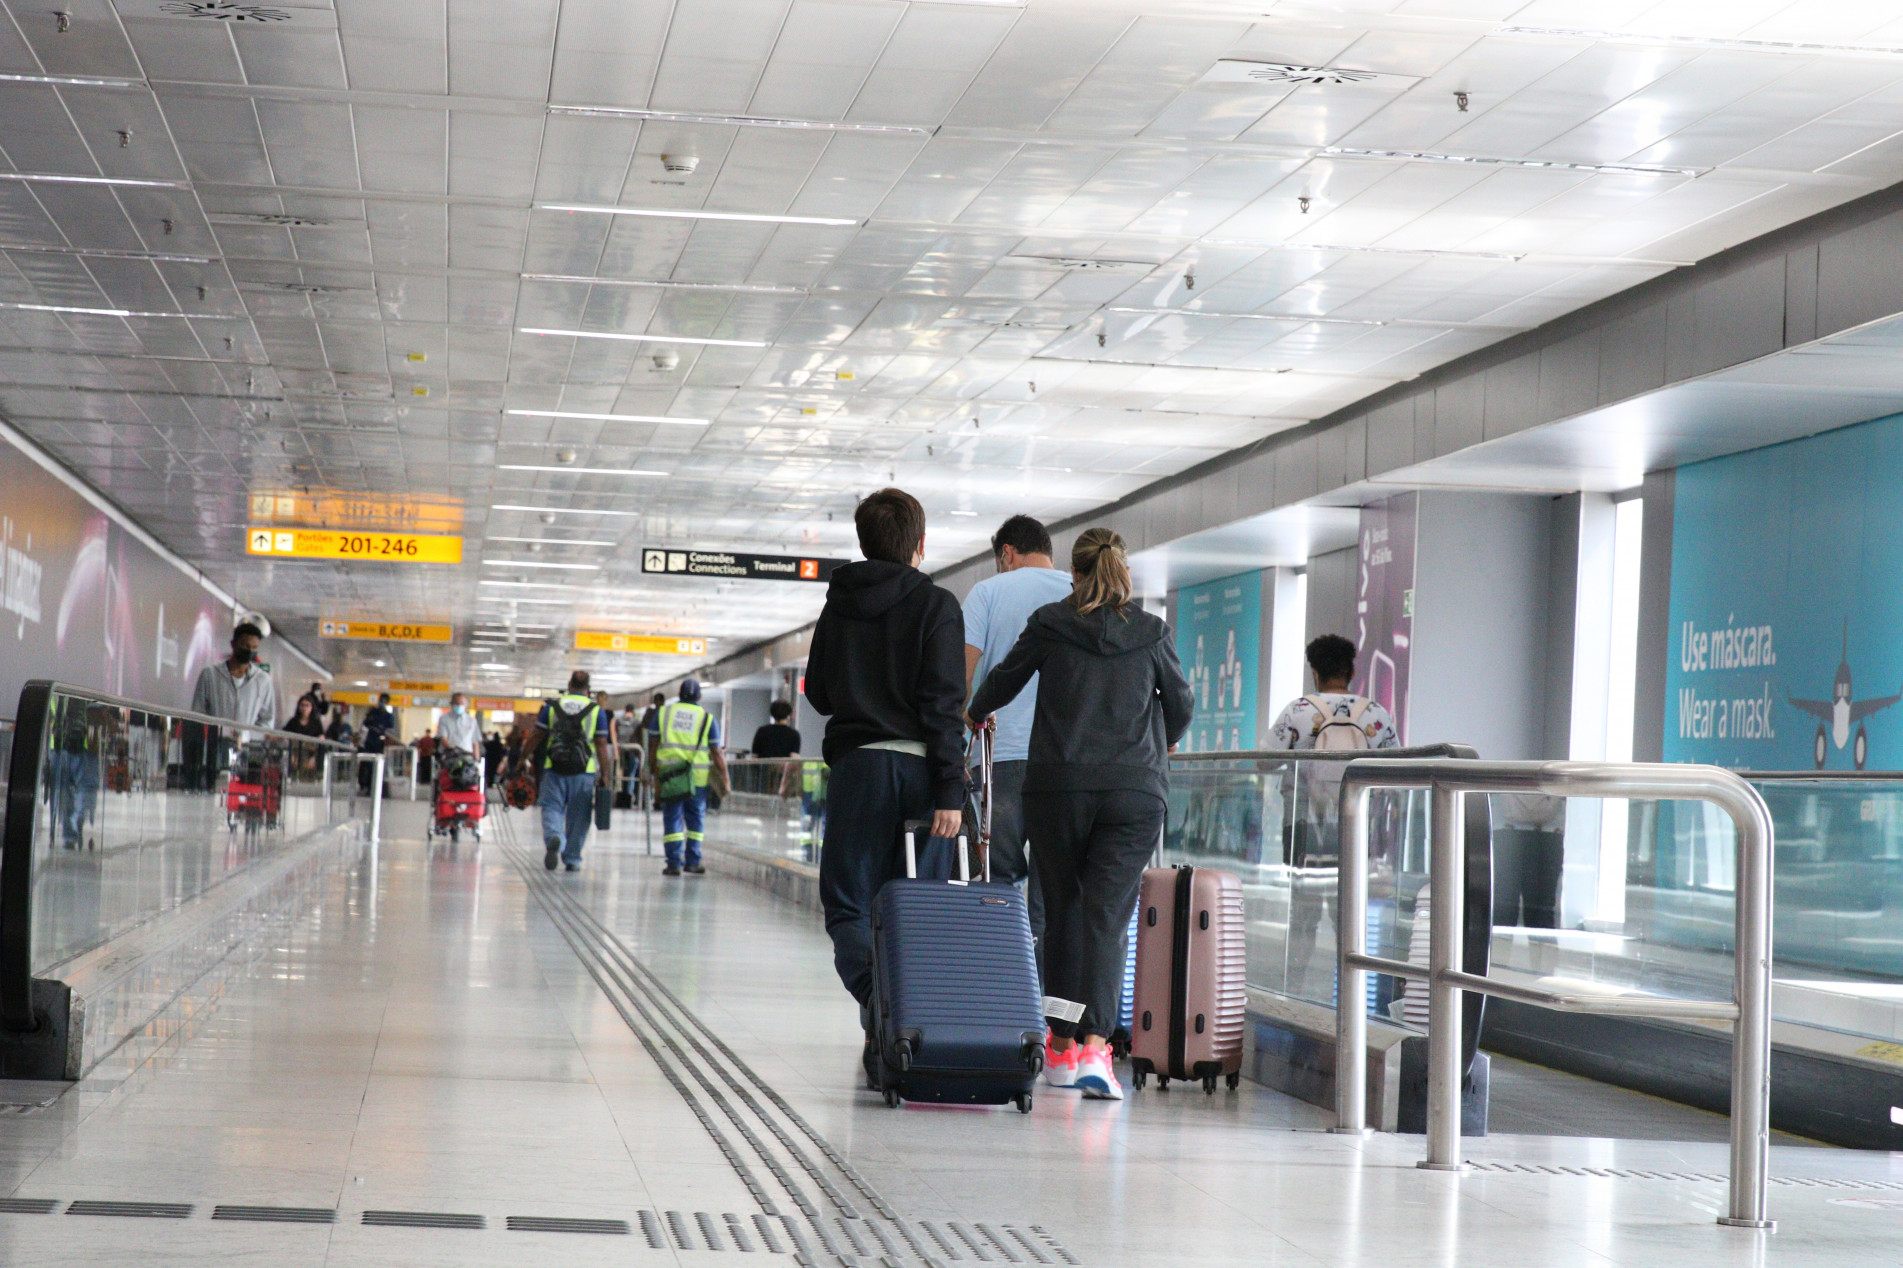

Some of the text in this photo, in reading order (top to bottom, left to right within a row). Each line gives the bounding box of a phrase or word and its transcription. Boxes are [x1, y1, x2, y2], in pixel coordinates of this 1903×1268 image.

[339, 536, 418, 556] 201-246
[689, 552, 736, 564] Conexões
[689, 563, 747, 576] Connections
[753, 560, 814, 576] Terminal 2
[1682, 611, 1776, 672] Use máscara.
[1679, 681, 1776, 739] Wear a mask.
